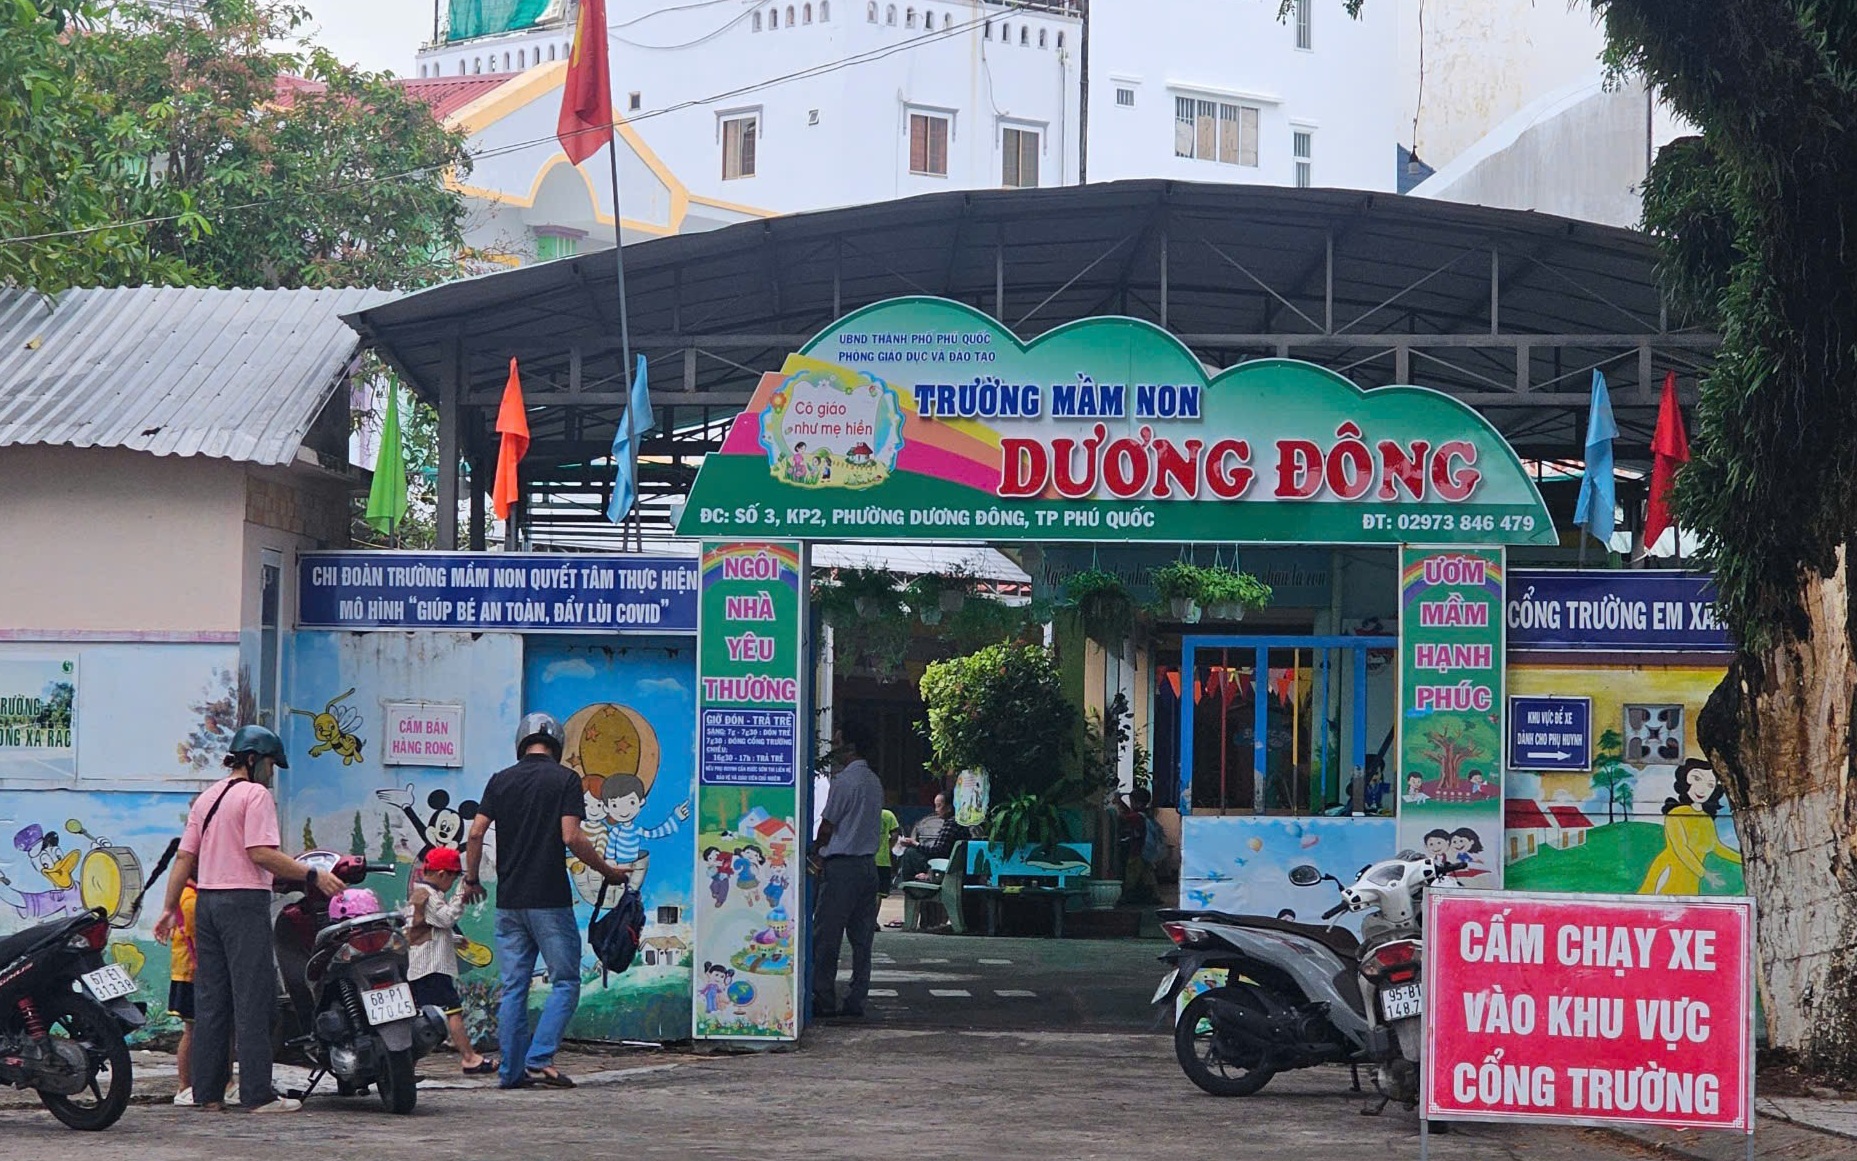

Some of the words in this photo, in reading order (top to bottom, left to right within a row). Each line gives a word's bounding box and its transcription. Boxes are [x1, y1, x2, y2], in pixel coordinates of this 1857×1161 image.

[839, 334, 868, 344] UBND
[872, 332, 907, 344] THÀNH
[911, 331, 933, 344] PHỐ
[937, 332, 958, 344] PHÚ
[962, 330, 991, 345] QUỐC
[838, 350, 874, 362] PHÒNG
[878, 349, 903, 362] GIÁO
[906, 352, 928, 364] DỤC
[931, 349, 945, 362] VÀ
[949, 349, 971, 362] ĐÀO
[974, 352, 996, 364] TẠO
[914, 376, 1041, 418] TRƯỜNG
[1051, 371, 1124, 418] MẦM
[1135, 384, 1200, 418] NON
[795, 401, 814, 415] Cô
[817, 401, 847, 418] giáo
[794, 422, 818, 435] như
[821, 424, 841, 438] mẹ
[845, 419, 873, 435] hiền
[997, 422, 1255, 500] DƯƠNG
[1274, 420, 1482, 501] ĐÔNG
[700, 507, 730, 524] ĐC:
[735, 503, 761, 524] SỐ
[764, 509, 781, 527] 3,
[786, 508, 827, 527] KP2,
[832, 505, 904, 525] PHƯỜNG
[910, 507, 970, 526] DƯƠNG
[975, 506, 1029, 529] ĐÔNG,
[1035, 510, 1059, 526] TP
[1064, 507, 1100, 527] PHÚ
[1106, 505, 1155, 529] QUỐC
[1362, 514, 1392, 530] ĐT:
[1397, 514, 1454, 530] 02973
[1460, 515, 1494, 531] 846
[1500, 515, 1535, 531] 479
[312, 566, 337, 586] CHI
[341, 563, 383, 587] ĐOÀN
[387, 563, 447, 587] TRƯỜNG
[451, 561, 489, 588] MẦM
[493, 568, 526, 588] NON
[530, 563, 577, 591] QUYẾT
[581, 565, 614, 589] TÂM
[618, 568, 657, 593] THỰC
[661, 566, 698, 594] HIỆN
[723, 551, 779, 580] NGÔI
[1424, 556, 1486, 585] ƯƠM
[339, 596, 364, 620] MÔ
[367, 597, 404, 620] HÌNH
[456, 597, 476, 621] BÉ
[480, 602, 501, 622] AN
[505, 598, 550, 624] TOÀN,
[554, 594, 584, 622] ĐẨY
[588, 598, 611, 623] LÙI
[726, 591, 776, 621] NHÀ
[1420, 592, 1488, 627] MẦM
[1507, 585, 1561, 629] CỔNG
[1566, 593, 1646, 630] TRƯỜNG
[1652, 602, 1683, 630] EM
[725, 631, 774, 662] YÊU
[1415, 644, 1492, 673] HẠNH
[702, 674, 797, 702] THƯƠNG
[1415, 680, 1492, 711] PHÚC
[0, 694, 41, 716] RƯỜNG
[1528, 711, 1541, 724] KHU
[1541, 709, 1554, 727] VỰC
[1555, 706, 1564, 725] ĐỂ
[1564, 712, 1573, 725] XE
[399, 715, 423, 734] CẤM
[426, 717, 449, 735] BÁN
[706, 713, 722, 725] GIỜ
[725, 713, 745, 725] ĐÓN
[752, 713, 771, 725] TRẢ
[773, 713, 792, 726] TRẺ
[392, 736, 422, 754] HÀNG
[425, 741, 454, 755] RONG
[1517, 730, 1534, 745] DÀNH
[1535, 733, 1548, 746] CHO
[1548, 733, 1561, 749] PHỤ
[1562, 734, 1583, 746] HUYNH
[1459, 908, 1545, 965] CẤM
[1557, 924, 1657, 977] CHẠY
[1667, 928, 1717, 971] XE
[95, 979, 135, 999] 313.38
[370, 987, 403, 1006] 68-P1
[1389, 984, 1421, 1002] 95-B1
[371, 1001, 412, 1021] 470.45
[1387, 999, 1420, 1017] 148.7
[1462, 984, 1536, 1036] VÀO
[1548, 995, 1624, 1039] KHU
[1636, 996, 1711, 1051] VỰC
[1453, 1048, 1555, 1107] CỔNG
[1567, 1060, 1720, 1115] TRƯỜNG
